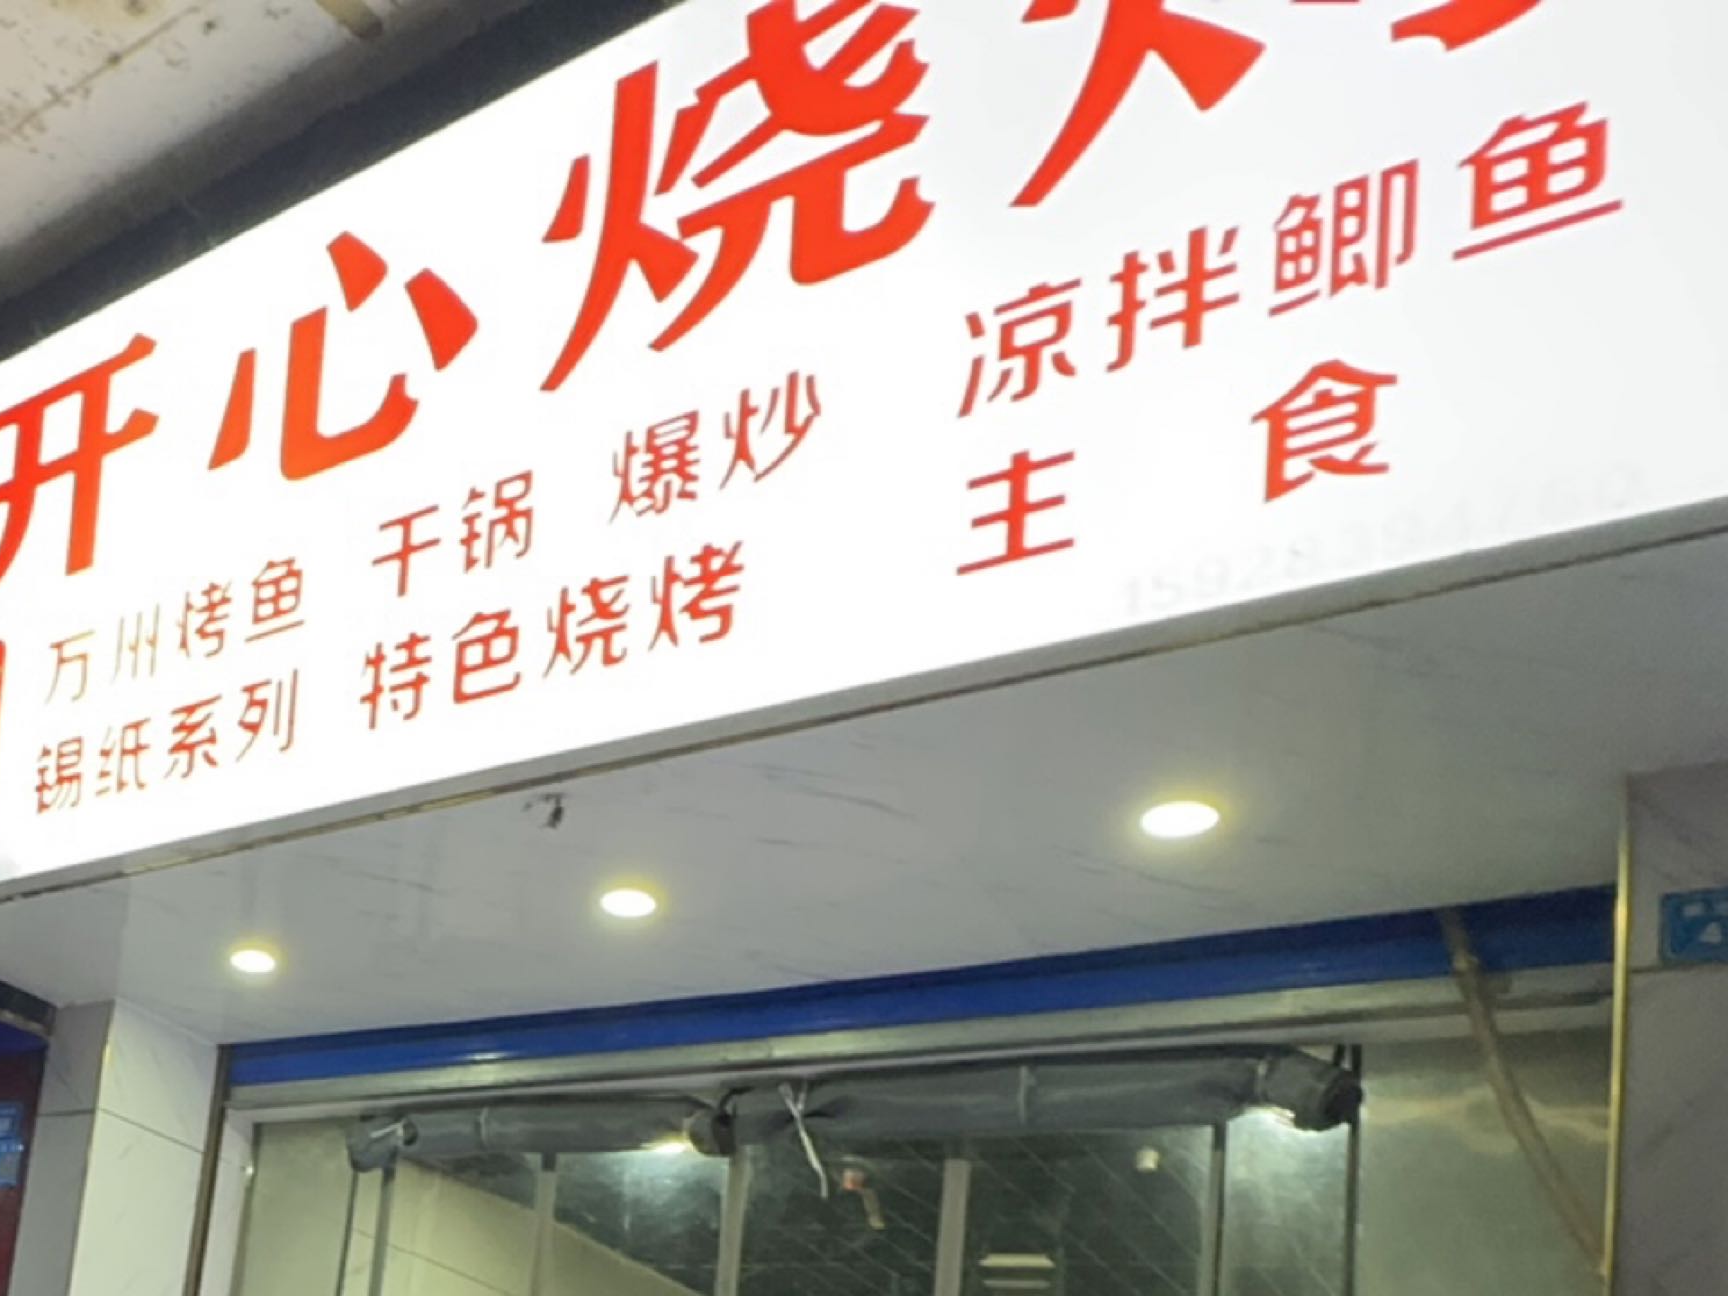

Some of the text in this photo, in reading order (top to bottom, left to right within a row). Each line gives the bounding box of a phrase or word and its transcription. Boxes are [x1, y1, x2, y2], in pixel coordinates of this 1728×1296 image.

[35, 358, 1399, 816] 锡纸系列 特色烧烤 主食
[43, 100, 1623, 706] 万州烤鱼 干锅 爆炒 凉拌鲫鱼
